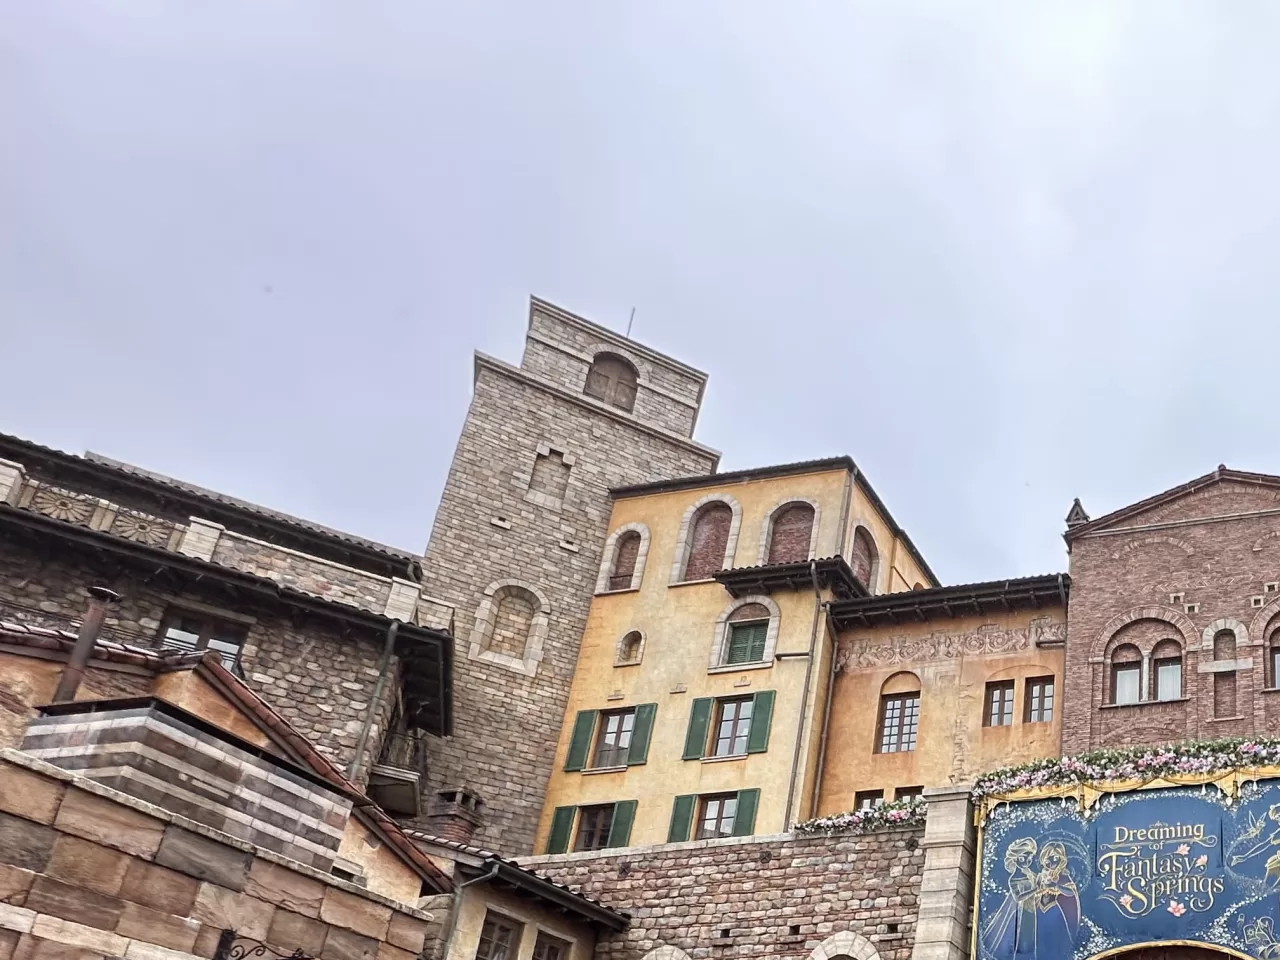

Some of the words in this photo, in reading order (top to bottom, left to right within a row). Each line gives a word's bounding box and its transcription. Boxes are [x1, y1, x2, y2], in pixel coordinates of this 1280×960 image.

[1114, 821, 1205, 843] Dreaming
[1152, 839, 1166, 851] of
[1097, 846, 1198, 893] Fantasy
[1127, 872, 1225, 917] Springs
